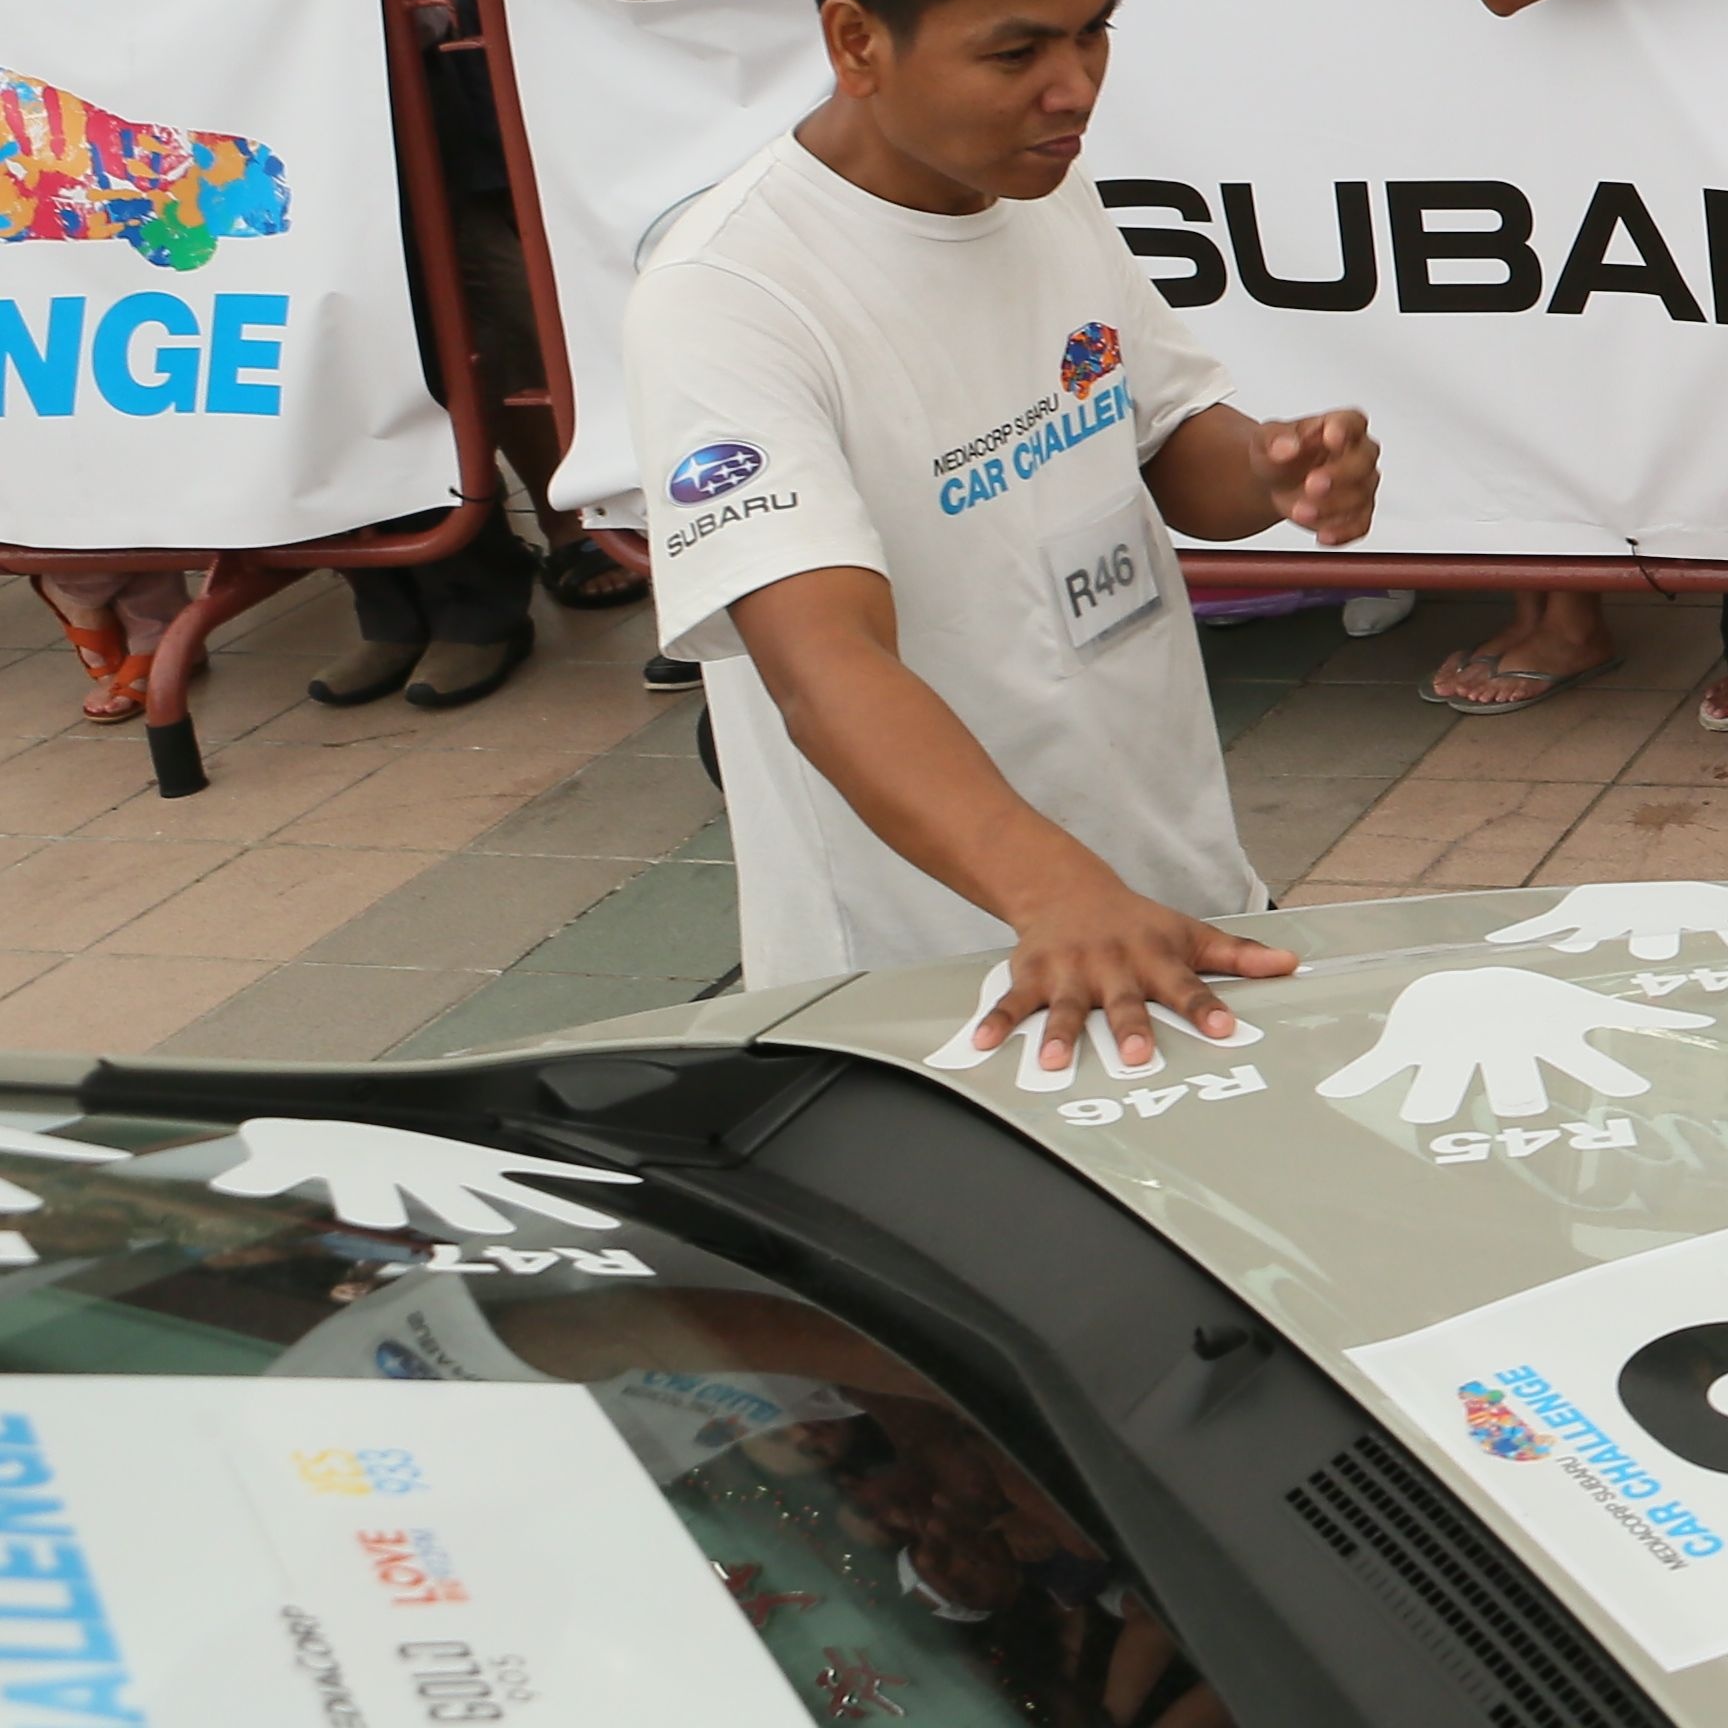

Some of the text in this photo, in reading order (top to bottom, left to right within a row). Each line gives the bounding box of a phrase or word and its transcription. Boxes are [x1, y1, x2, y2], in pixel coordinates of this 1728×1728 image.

[932, 392, 1060, 478] MEDIACORP SUBARU
[939, 457, 1009, 516] CAR
[666, 491, 799, 559] SUBARU
[1064, 542, 1135, 619] R46
[1055, 1064, 1270, 1128] R46
[1428, 1117, 1639, 1165] R45
[1493, 1364, 1725, 1558] CAR CHALLENGE
[1556, 1454, 1691, 1572] MEDIACORP SUBARU
